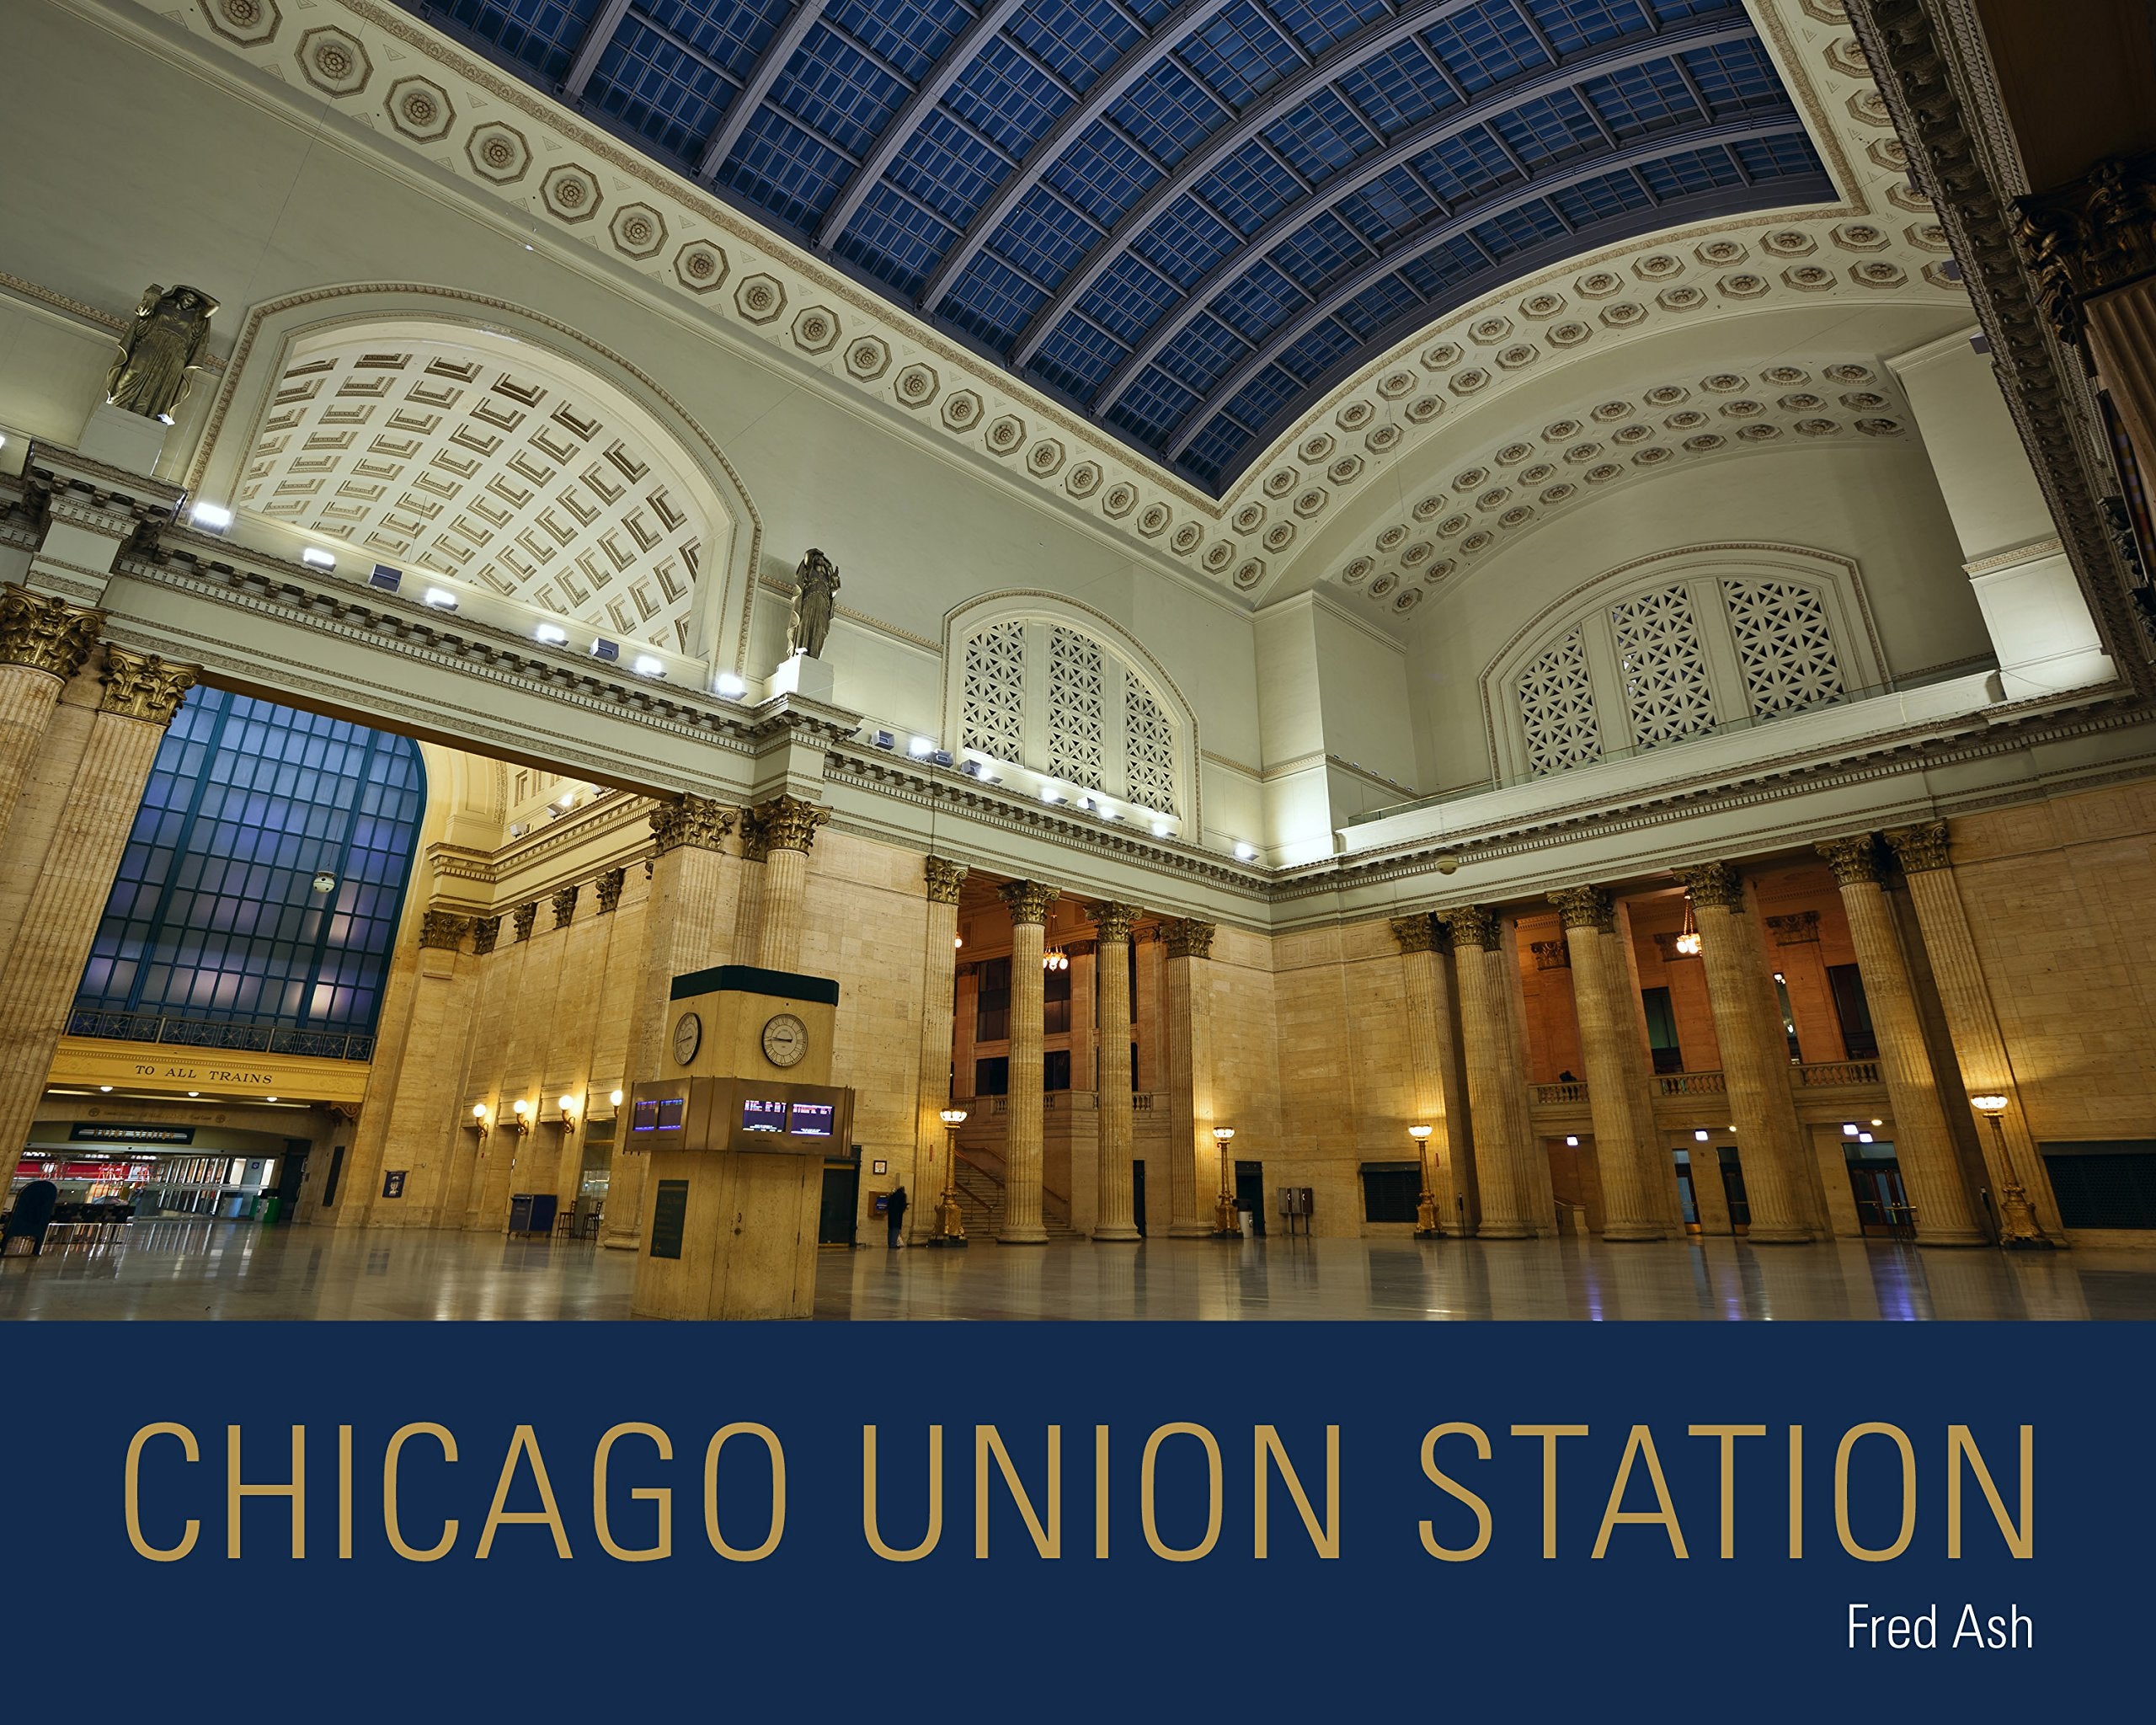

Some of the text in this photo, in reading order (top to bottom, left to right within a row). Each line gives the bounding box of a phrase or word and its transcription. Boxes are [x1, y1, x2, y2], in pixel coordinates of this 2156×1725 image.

[135, 1065, 273, 1084] TO ALL TRAINS
